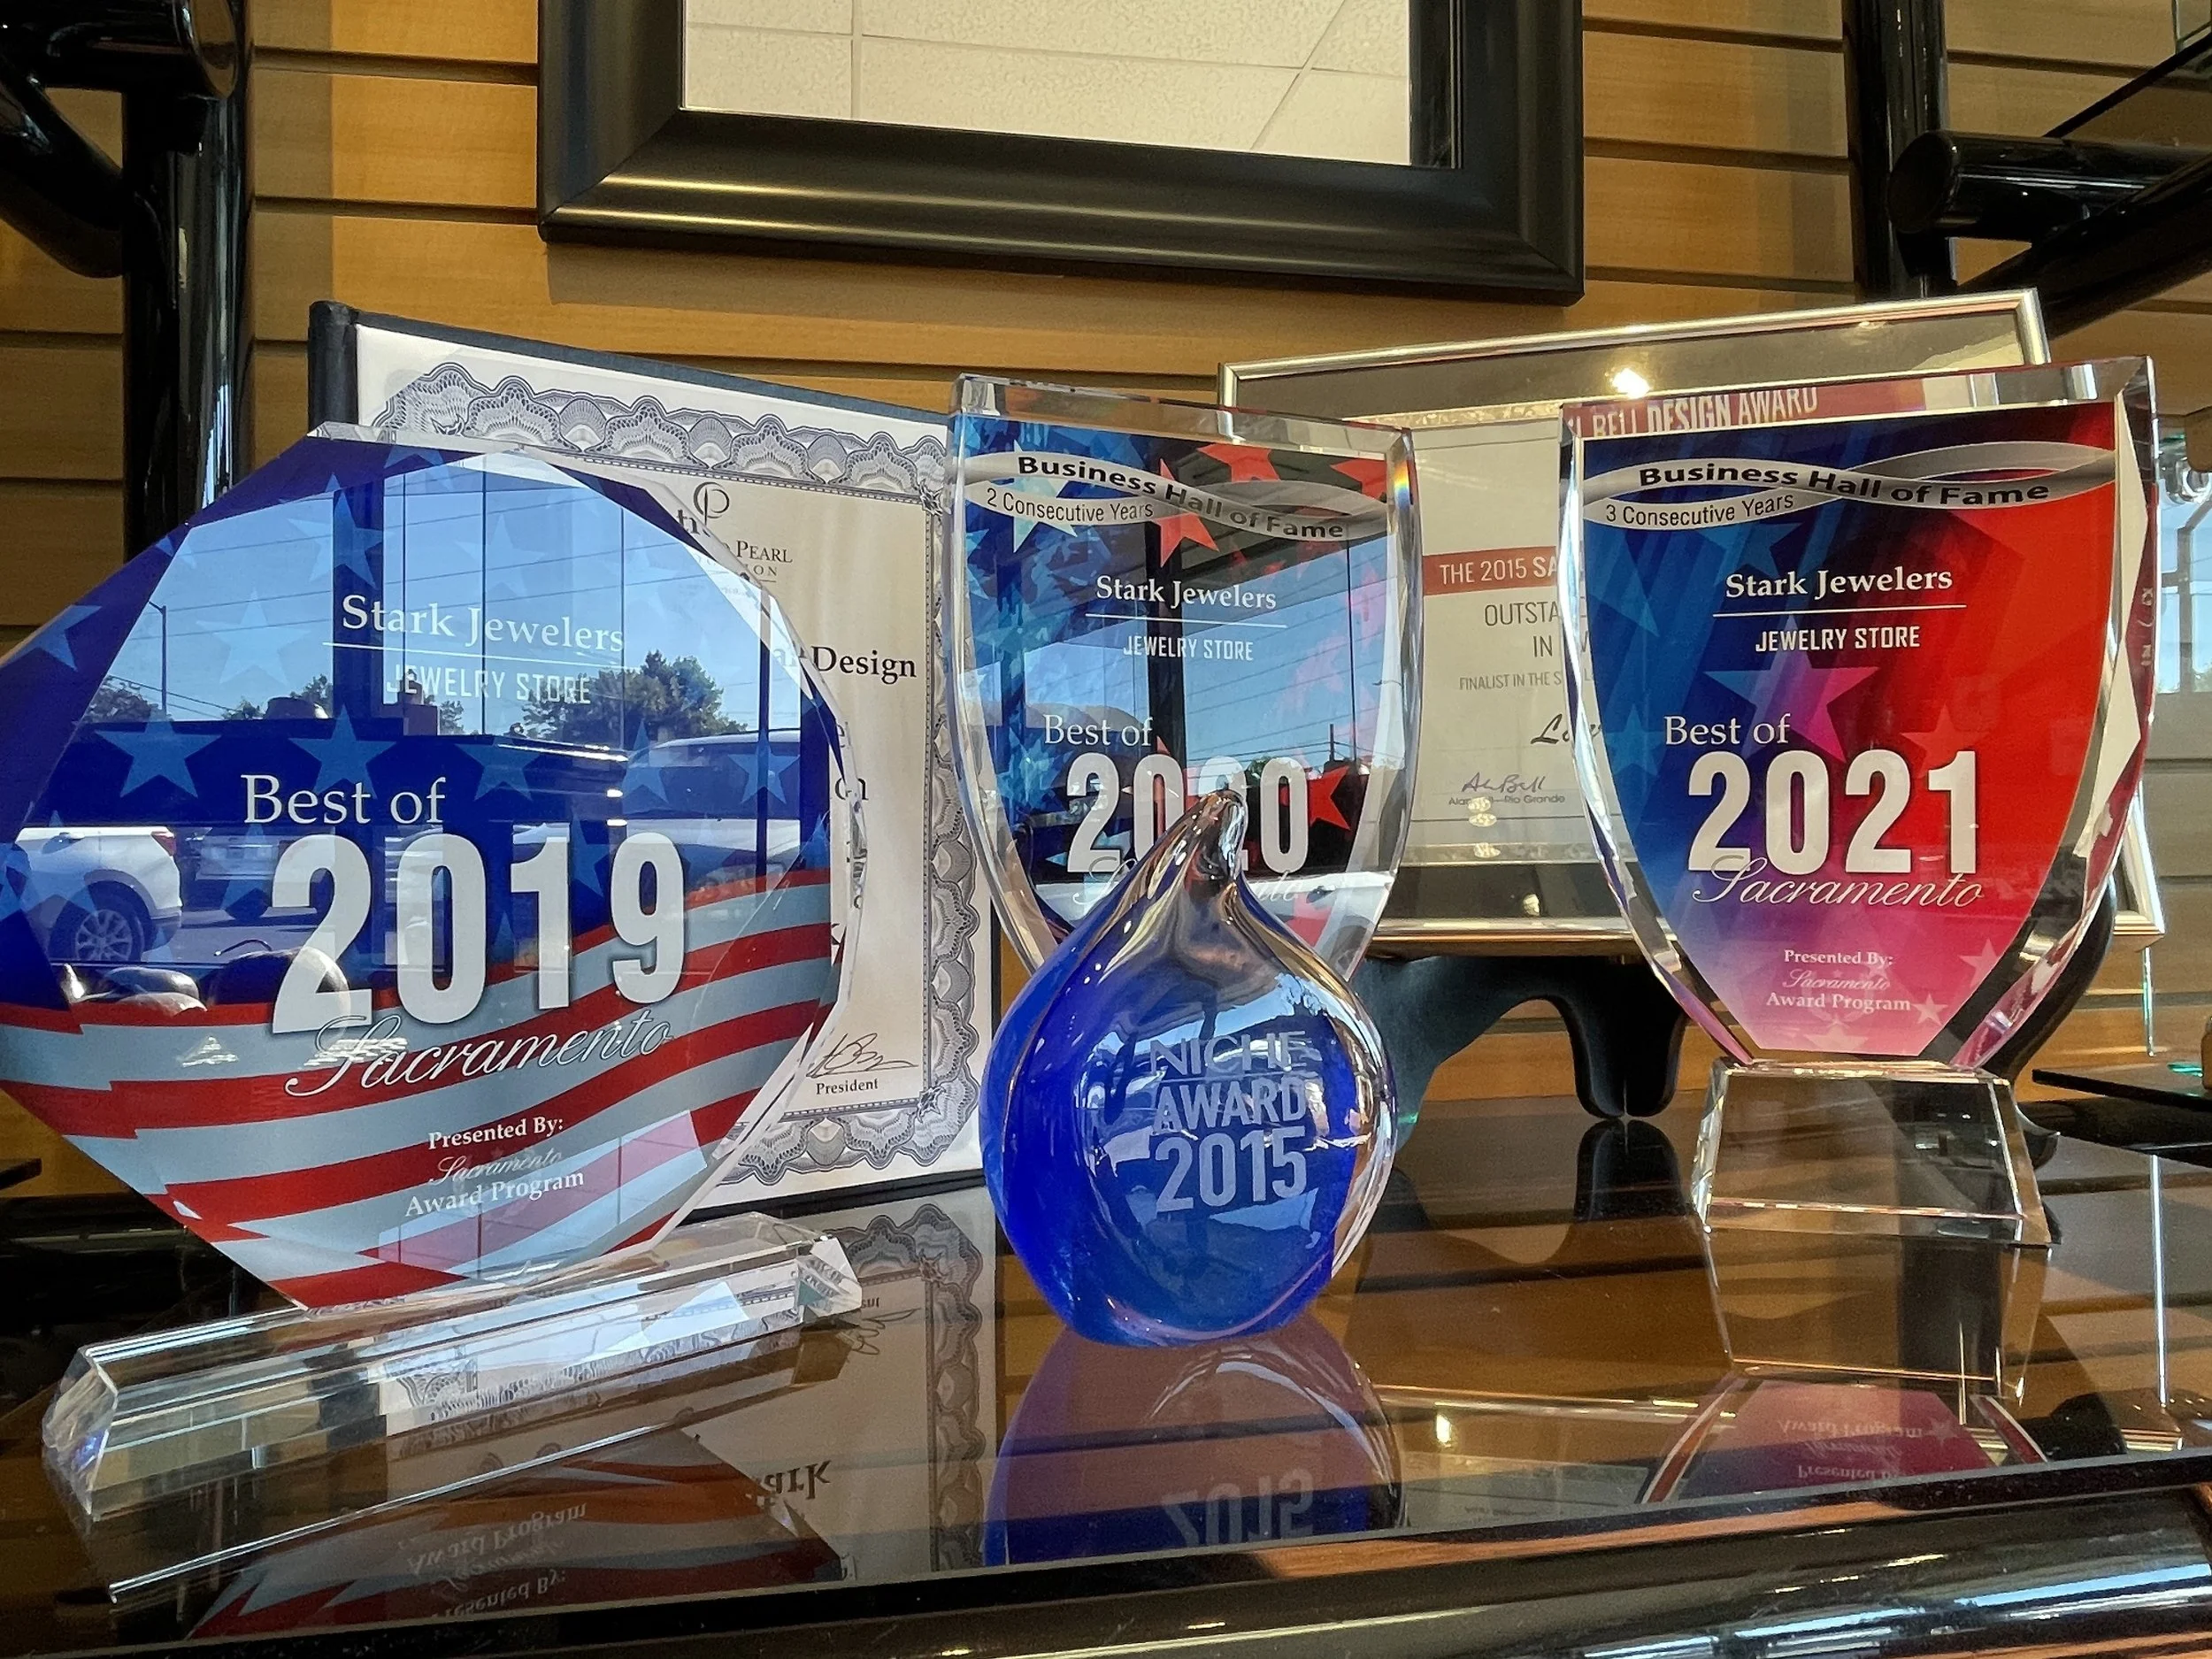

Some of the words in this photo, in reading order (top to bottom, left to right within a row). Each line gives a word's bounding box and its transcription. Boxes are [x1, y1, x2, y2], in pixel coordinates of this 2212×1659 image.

[1647, 395, 1731, 433] DESIGN
[1738, 387, 1817, 425] AWARD
[1018, 456, 1156, 495] Business
[1164, 483, 1223, 518] Hall
[1229, 510, 1260, 528] of
[1266, 516, 1344, 539] Fame
[1640, 463, 1798, 487] Business
[1809, 471, 1881, 498] Hall
[1891, 486, 1932, 503] of
[1939, 484, 2050, 505] Fame
[986, 488, 998, 508] 2
[1002, 491, 1105, 522] Consecutive
[1111, 501, 1154, 519] Years
[1606, 504, 1617, 522] 3
[1623, 505, 1735, 526] Consecutive
[1741, 494, 1793, 518] Years
[1440, 562, 1475, 586] THE
[1479, 557, 1527, 582] 2015
[1532, 556, 1557, 577] SA
[1725, 571, 1808, 598] Stark
[1814, 566, 1953, 600] Jewelers
[1095, 575, 1164, 603] Stark
[1171, 580, 1277, 610] Jewelers
[342, 594, 455, 637] Stark
[465, 606, 624, 652] Jewelers
[1484, 601, 1560, 626] OUTSTA
[1123, 635, 1197, 658] JEWELRY
[1203, 639, 1254, 662] STORE
[1532, 634, 1553, 657] IN
[1755, 628, 1847, 652] JEWELRY
[1855, 626, 1920, 649] STORE
[810, 646, 918, 685] Design
[1459, 673, 1510, 690] FINALIST
[1513, 672, 1525, 687] IN
[1527, 672, 1550, 686] THE
[386, 664, 506, 699] JEWELRY
[516, 672, 591, 704] STORE
[1042, 714, 1110, 746] Best
[1120, 717, 1154, 747] of
[1663, 715, 1741, 746] Best
[1752, 713, 1792, 745] of
[241, 774, 371, 825] Best
[390, 777, 446, 825] of
[1523, 795, 1566, 804] Grande
[1687, 749, 1977, 876] 2021
[1691, 855, 1985, 908] Sacramento
[271, 833, 687, 1034] 2019
[1784, 949, 1862, 964] Presented
[1867, 951, 1893, 970] By:
[1782, 969, 1891, 991] Sacramento
[1766, 992, 1825, 1008] Award
[1832, 993, 1911, 1015] Program
[284, 1010, 673, 1097] Sacramento
[1150, 1030, 1307, 1075] NICHE
[816, 1078, 879, 1095] President
[1151, 1078, 1307, 1135] AWARD
[427, 1118, 527, 1150] Presented
[533, 1116, 564, 1138] By:
[427, 1148, 563, 1186] Sacramento
[1155, 1125, 1308, 1213] 2015
[404, 1185, 482, 1217] Award
[491, 1171, 585, 1201] Program
